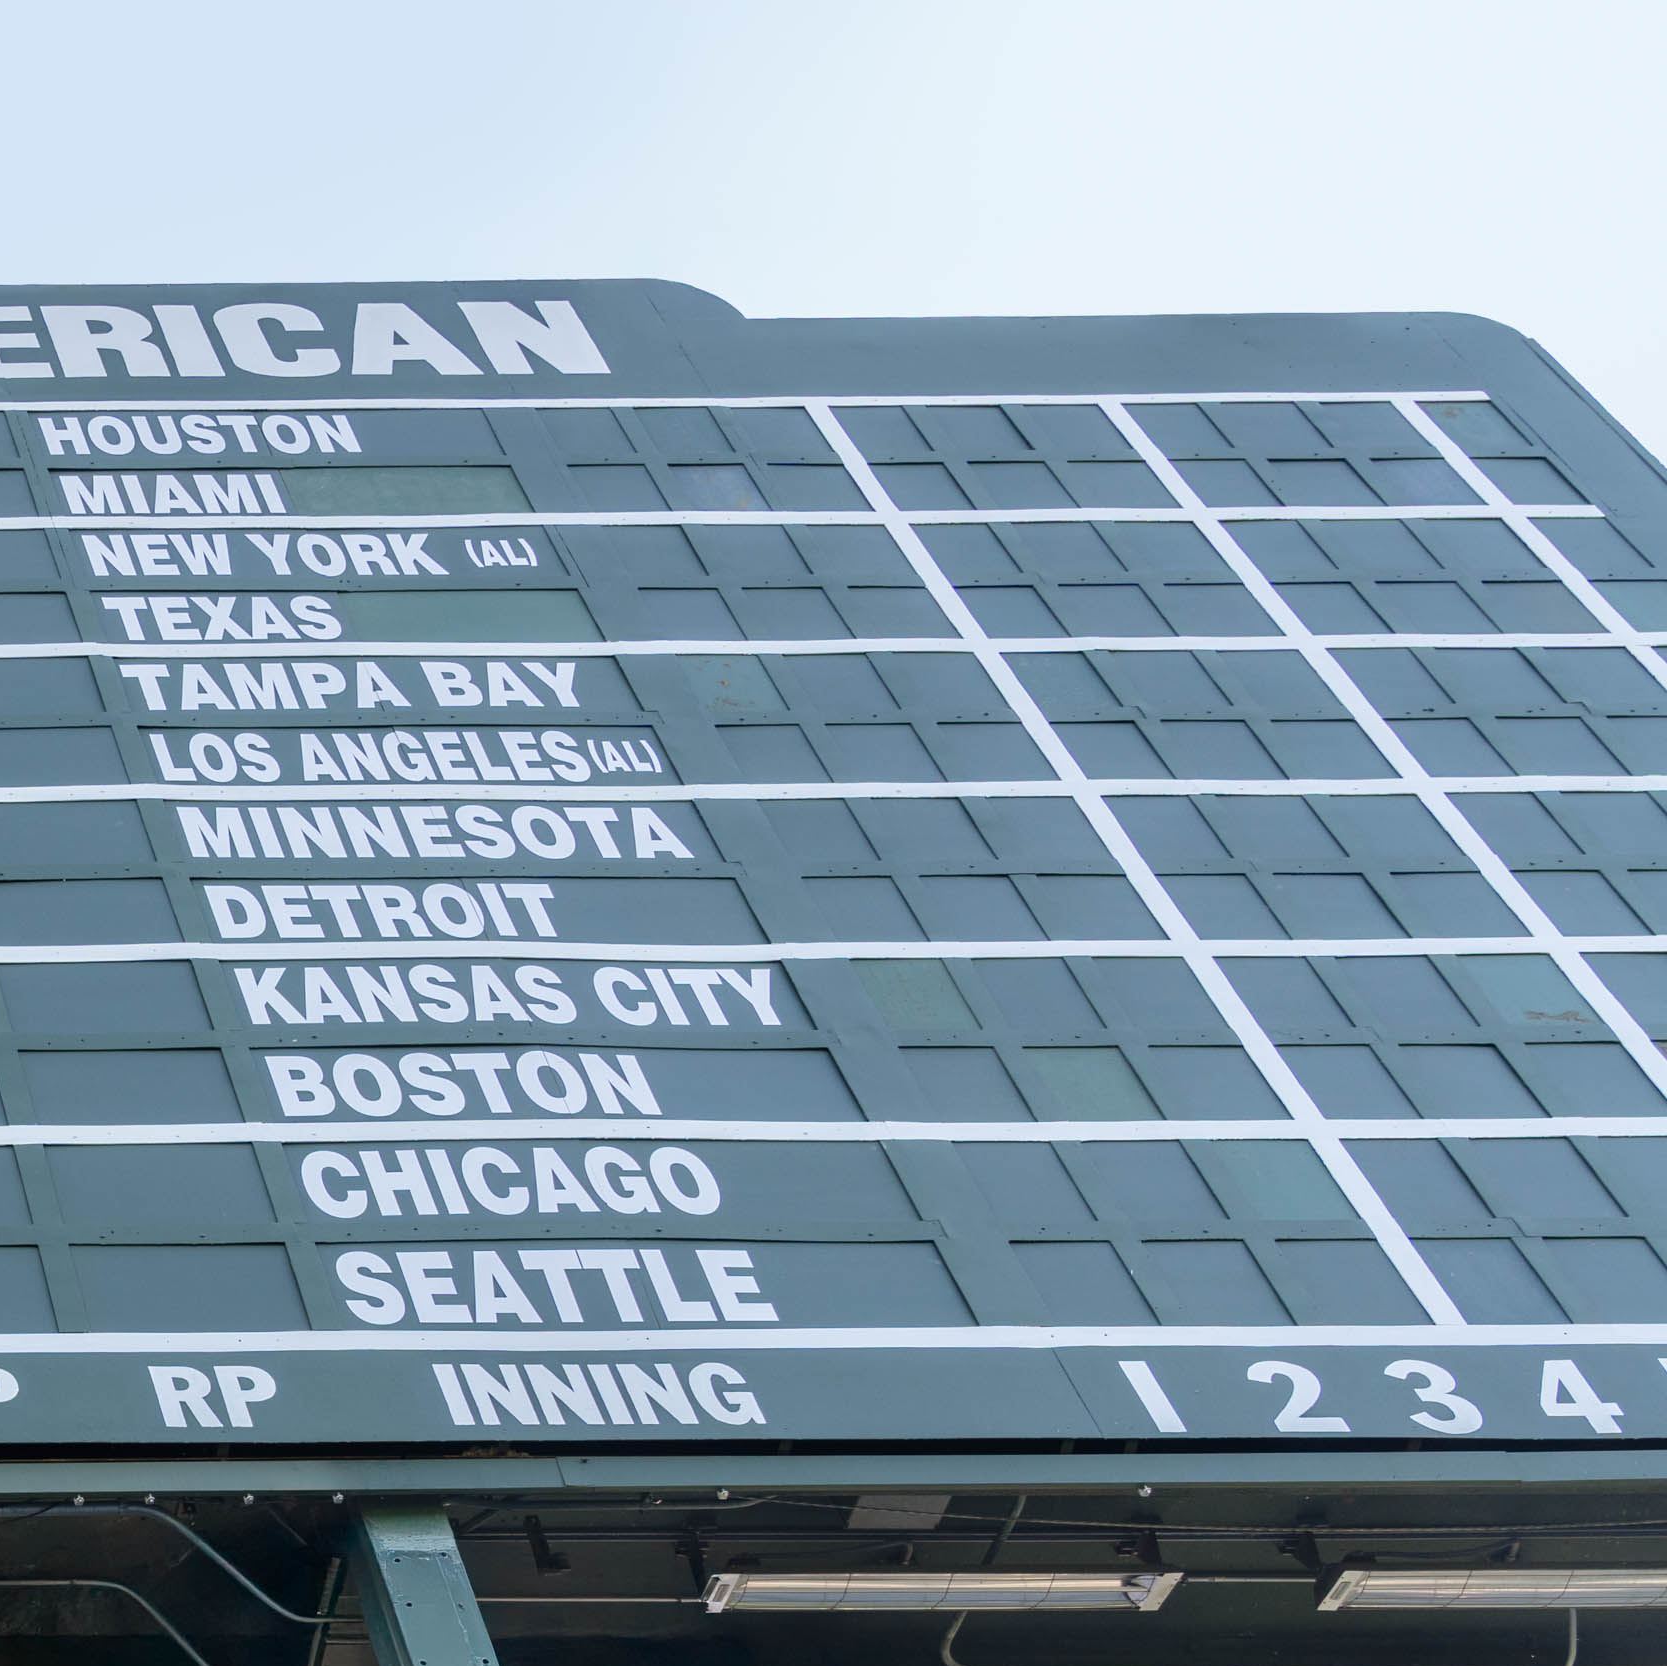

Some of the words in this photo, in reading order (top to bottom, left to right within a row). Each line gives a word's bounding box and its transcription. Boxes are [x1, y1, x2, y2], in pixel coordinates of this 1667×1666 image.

[38, 415, 362, 455] HOUSTON
[59, 474, 286, 514] MIAMI
[82, 534, 231, 576] NEW
[245, 534, 449, 576] YORK
[465, 538, 537, 567] (AL)
[101, 596, 342, 640] TEXAS
[119, 662, 411, 710] TAMPA
[425, 662, 579, 707] BAY
[149, 733, 280, 782] LOS
[176, 805, 694, 859] MINNESOTA
[204, 883, 557, 938] DETROIT
[234, 965, 577, 1024] KANSAS
[594, 967, 781, 1026] CITY
[265, 1051, 662, 1116] BOSTON
[302, 1146, 720, 1218] CHICAGO
[336, 1249, 779, 1325] SEATTLE
[148, 1366, 276, 1427] RP
[432, 1363, 766, 1425] INNING
[1118, 1361, 1187, 1432] 1
[1247, 1361, 1351, 1432] 2
[1384, 1360, 1483, 1434] 3
[1540, 1360, 1624, 1433] 4
